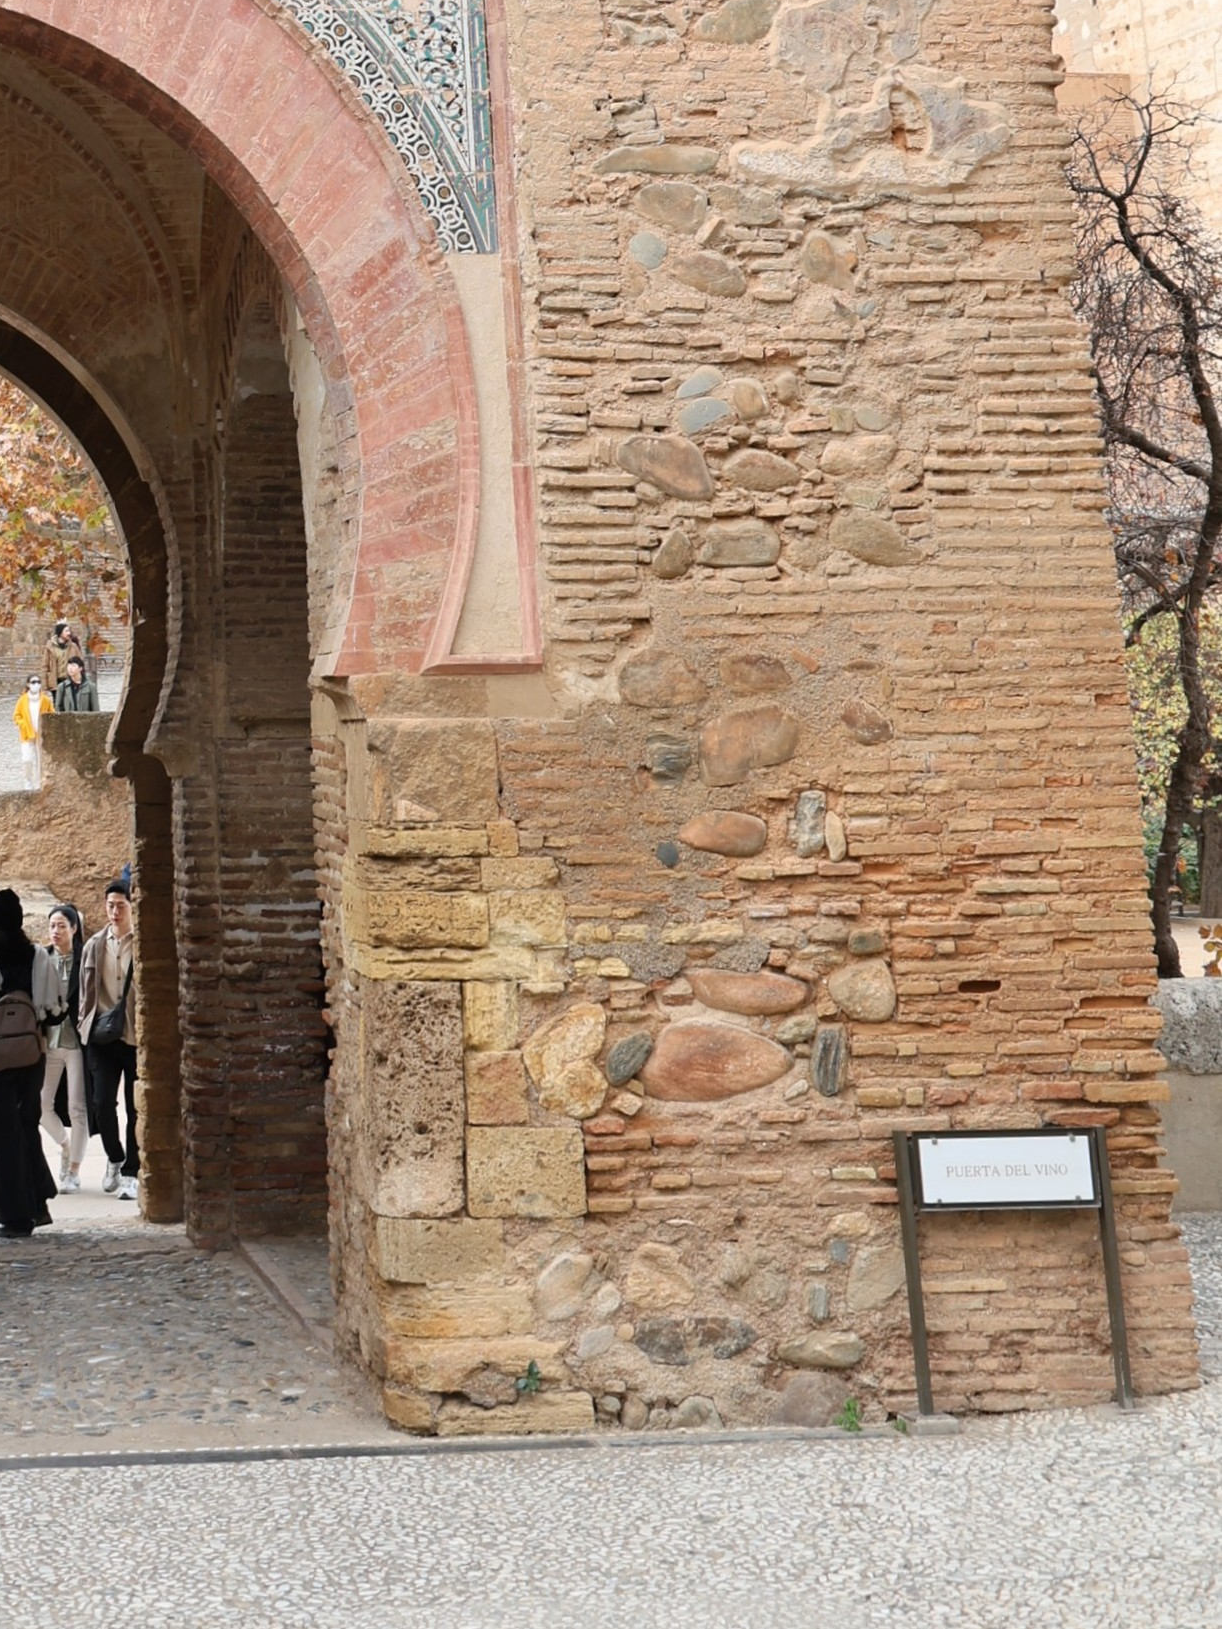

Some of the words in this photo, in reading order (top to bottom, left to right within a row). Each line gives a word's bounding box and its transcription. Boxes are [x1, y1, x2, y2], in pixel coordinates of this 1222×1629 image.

[945, 1164, 1001, 1178] PUERTA
[1004, 1164, 1032, 1177] DEL
[1034, 1163, 1068, 1176] VINO
